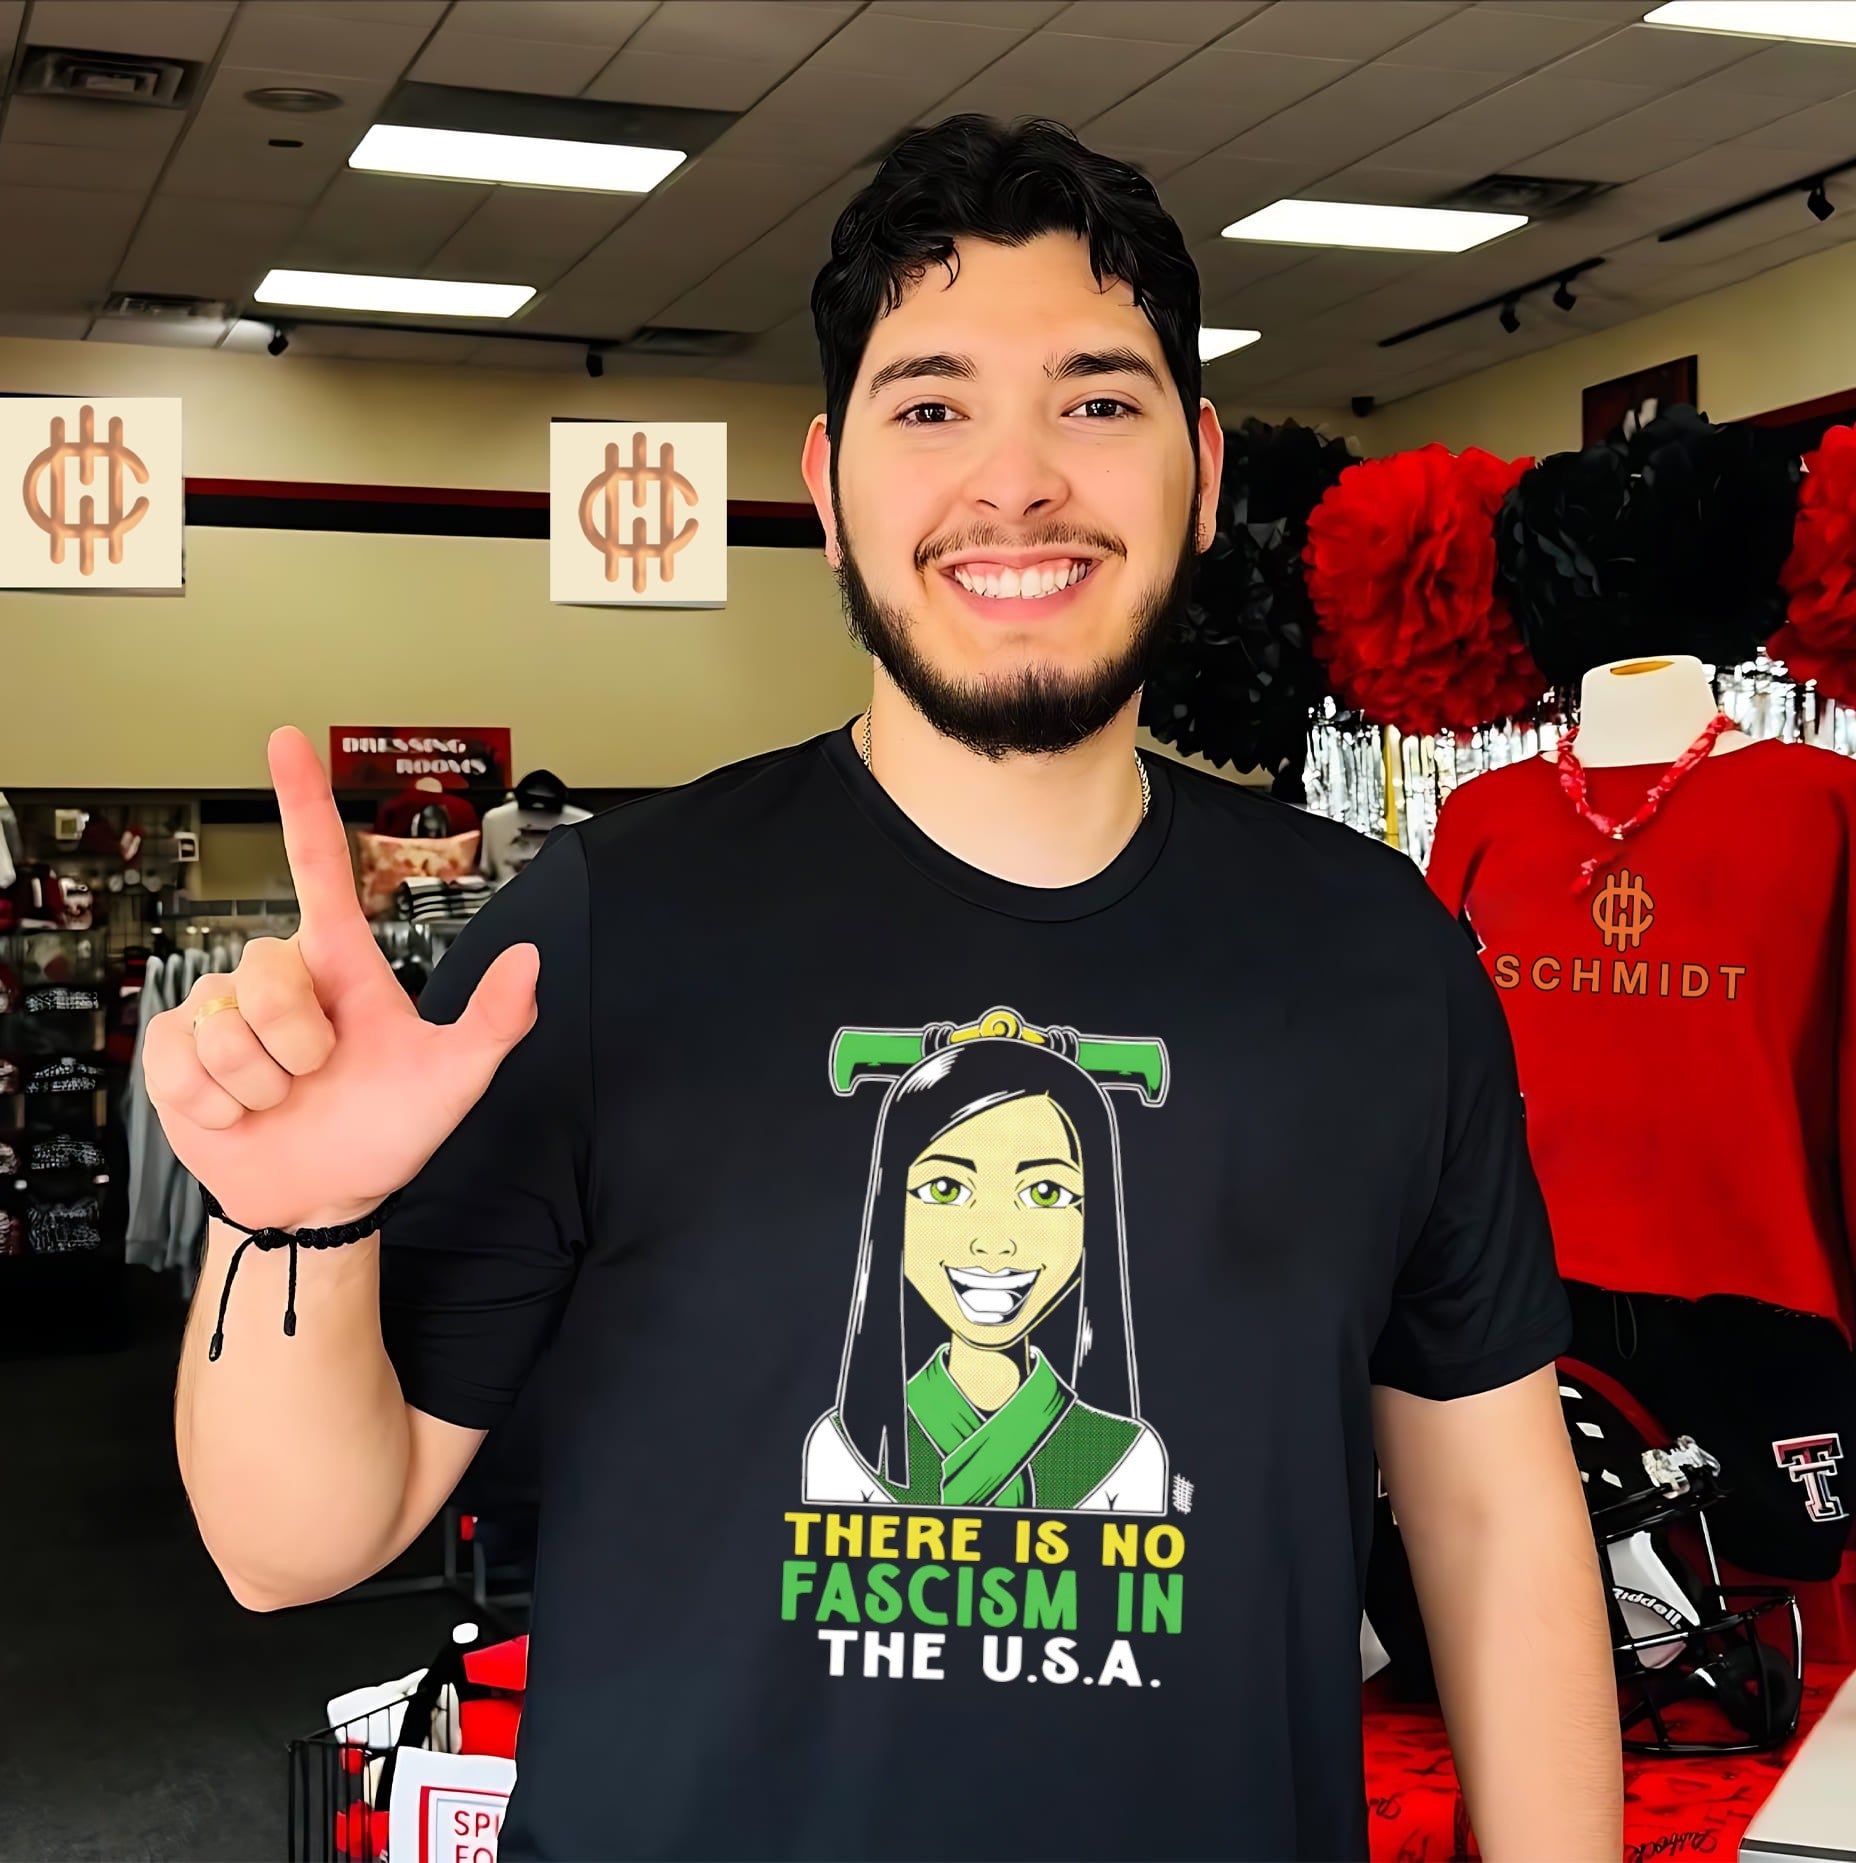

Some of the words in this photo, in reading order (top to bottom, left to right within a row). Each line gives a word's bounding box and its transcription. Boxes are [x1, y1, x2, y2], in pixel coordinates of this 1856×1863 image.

[342, 737, 466, 753] DRESSING
[396, 759, 487, 775] ROOMS
[1494, 954, 1748, 1001] SCHMIDT
[783, 1512, 982, 1561] THERE
[1015, 1520, 1070, 1564] IS
[1101, 1523, 1186, 1569] NO
[781, 1560, 1077, 1631] FASCISM
[1116, 1572, 1184, 1634] IN
[817, 1629, 946, 1679] THE
[981, 1635, 1162, 1688] U.S.A.
